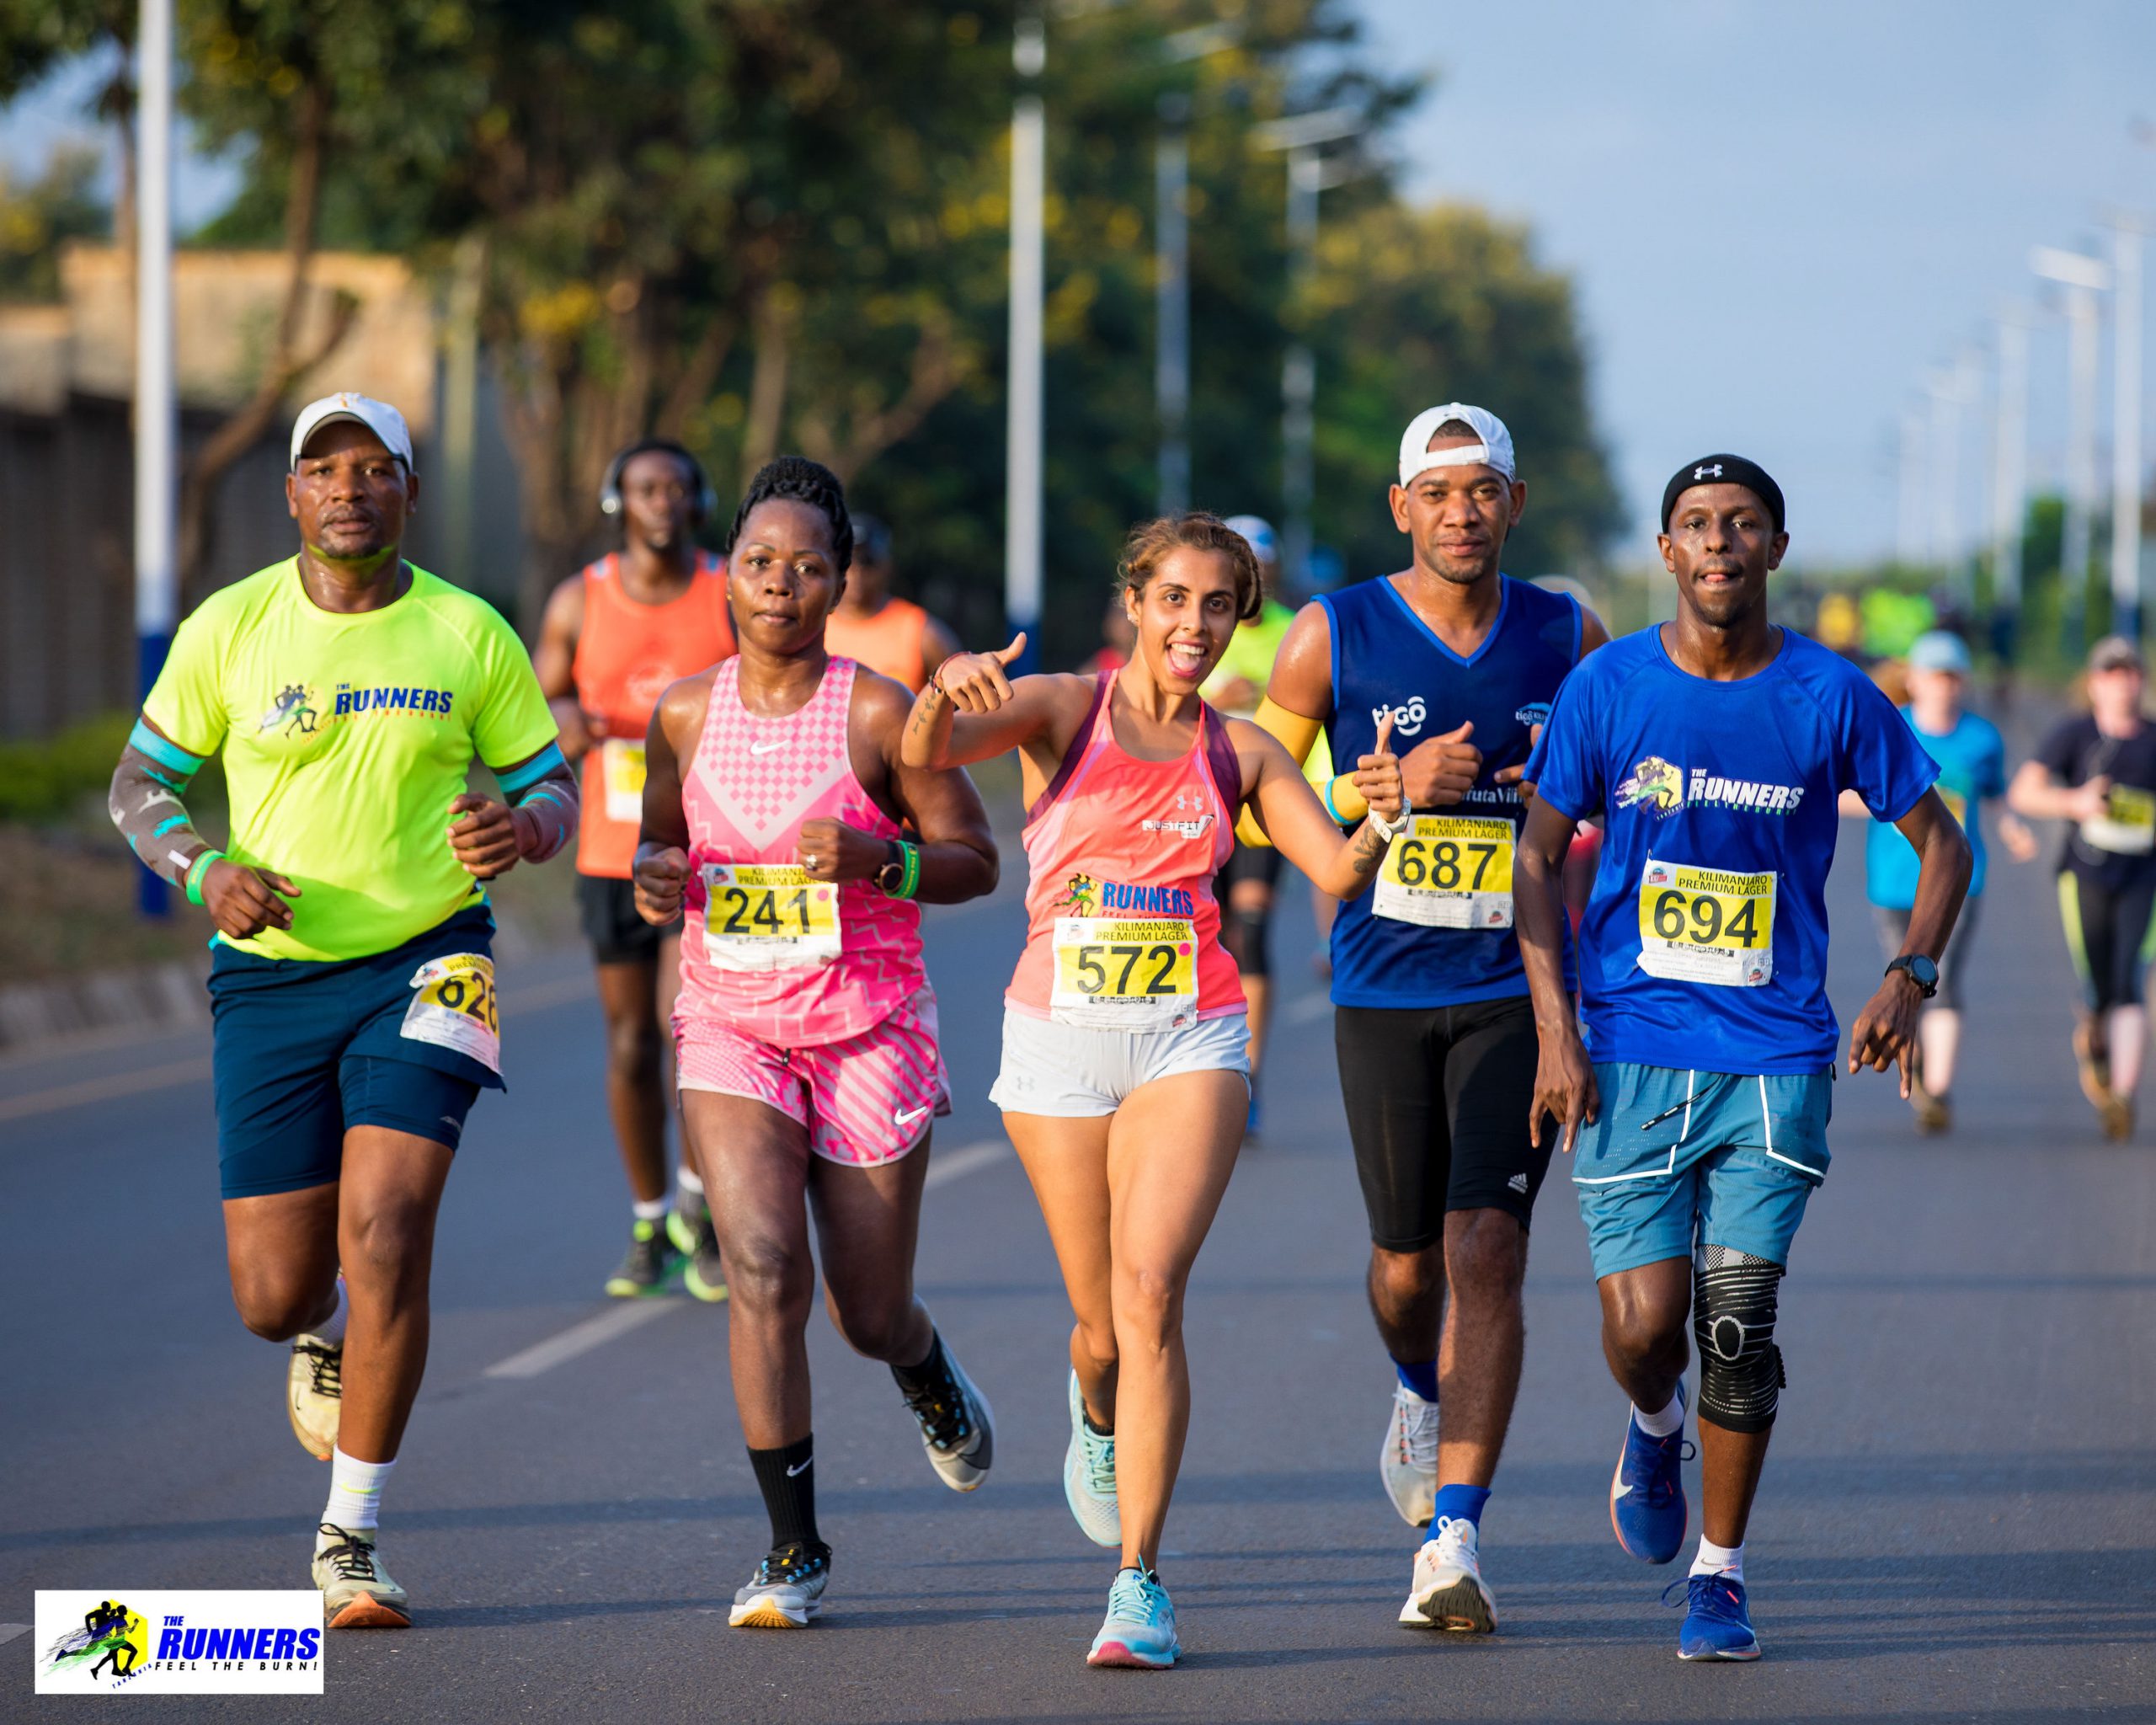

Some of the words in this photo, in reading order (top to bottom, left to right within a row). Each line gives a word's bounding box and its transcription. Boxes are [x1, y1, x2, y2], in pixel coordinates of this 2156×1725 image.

[334, 687, 453, 715] RUNNERS
[1691, 768, 1707, 777] THE
[1688, 777, 1805, 809] RUNNERS
[1418, 827, 1472, 838] PREMIUM
[1475, 828, 1508, 839] LAGER
[1437, 819, 1508, 830] KILIMANJARO
[1397, 841, 1497, 890] 687
[738, 875, 787, 885] PREMIUM
[1679, 878, 1735, 895] PREMIUM
[1738, 884, 1768, 895] LAGER
[1699, 871, 1768, 885] KILIMANJARO
[1102, 882, 1194, 916] RUNNERS
[723, 888, 810, 934] 241
[1654, 890, 1758, 948] 694
[1114, 922, 1184, 932] KILIMANJARO
[1096, 931, 1151, 942] PREMIUM
[1155, 932, 1188, 941] LAGER
[1077, 945, 1177, 994] 572
